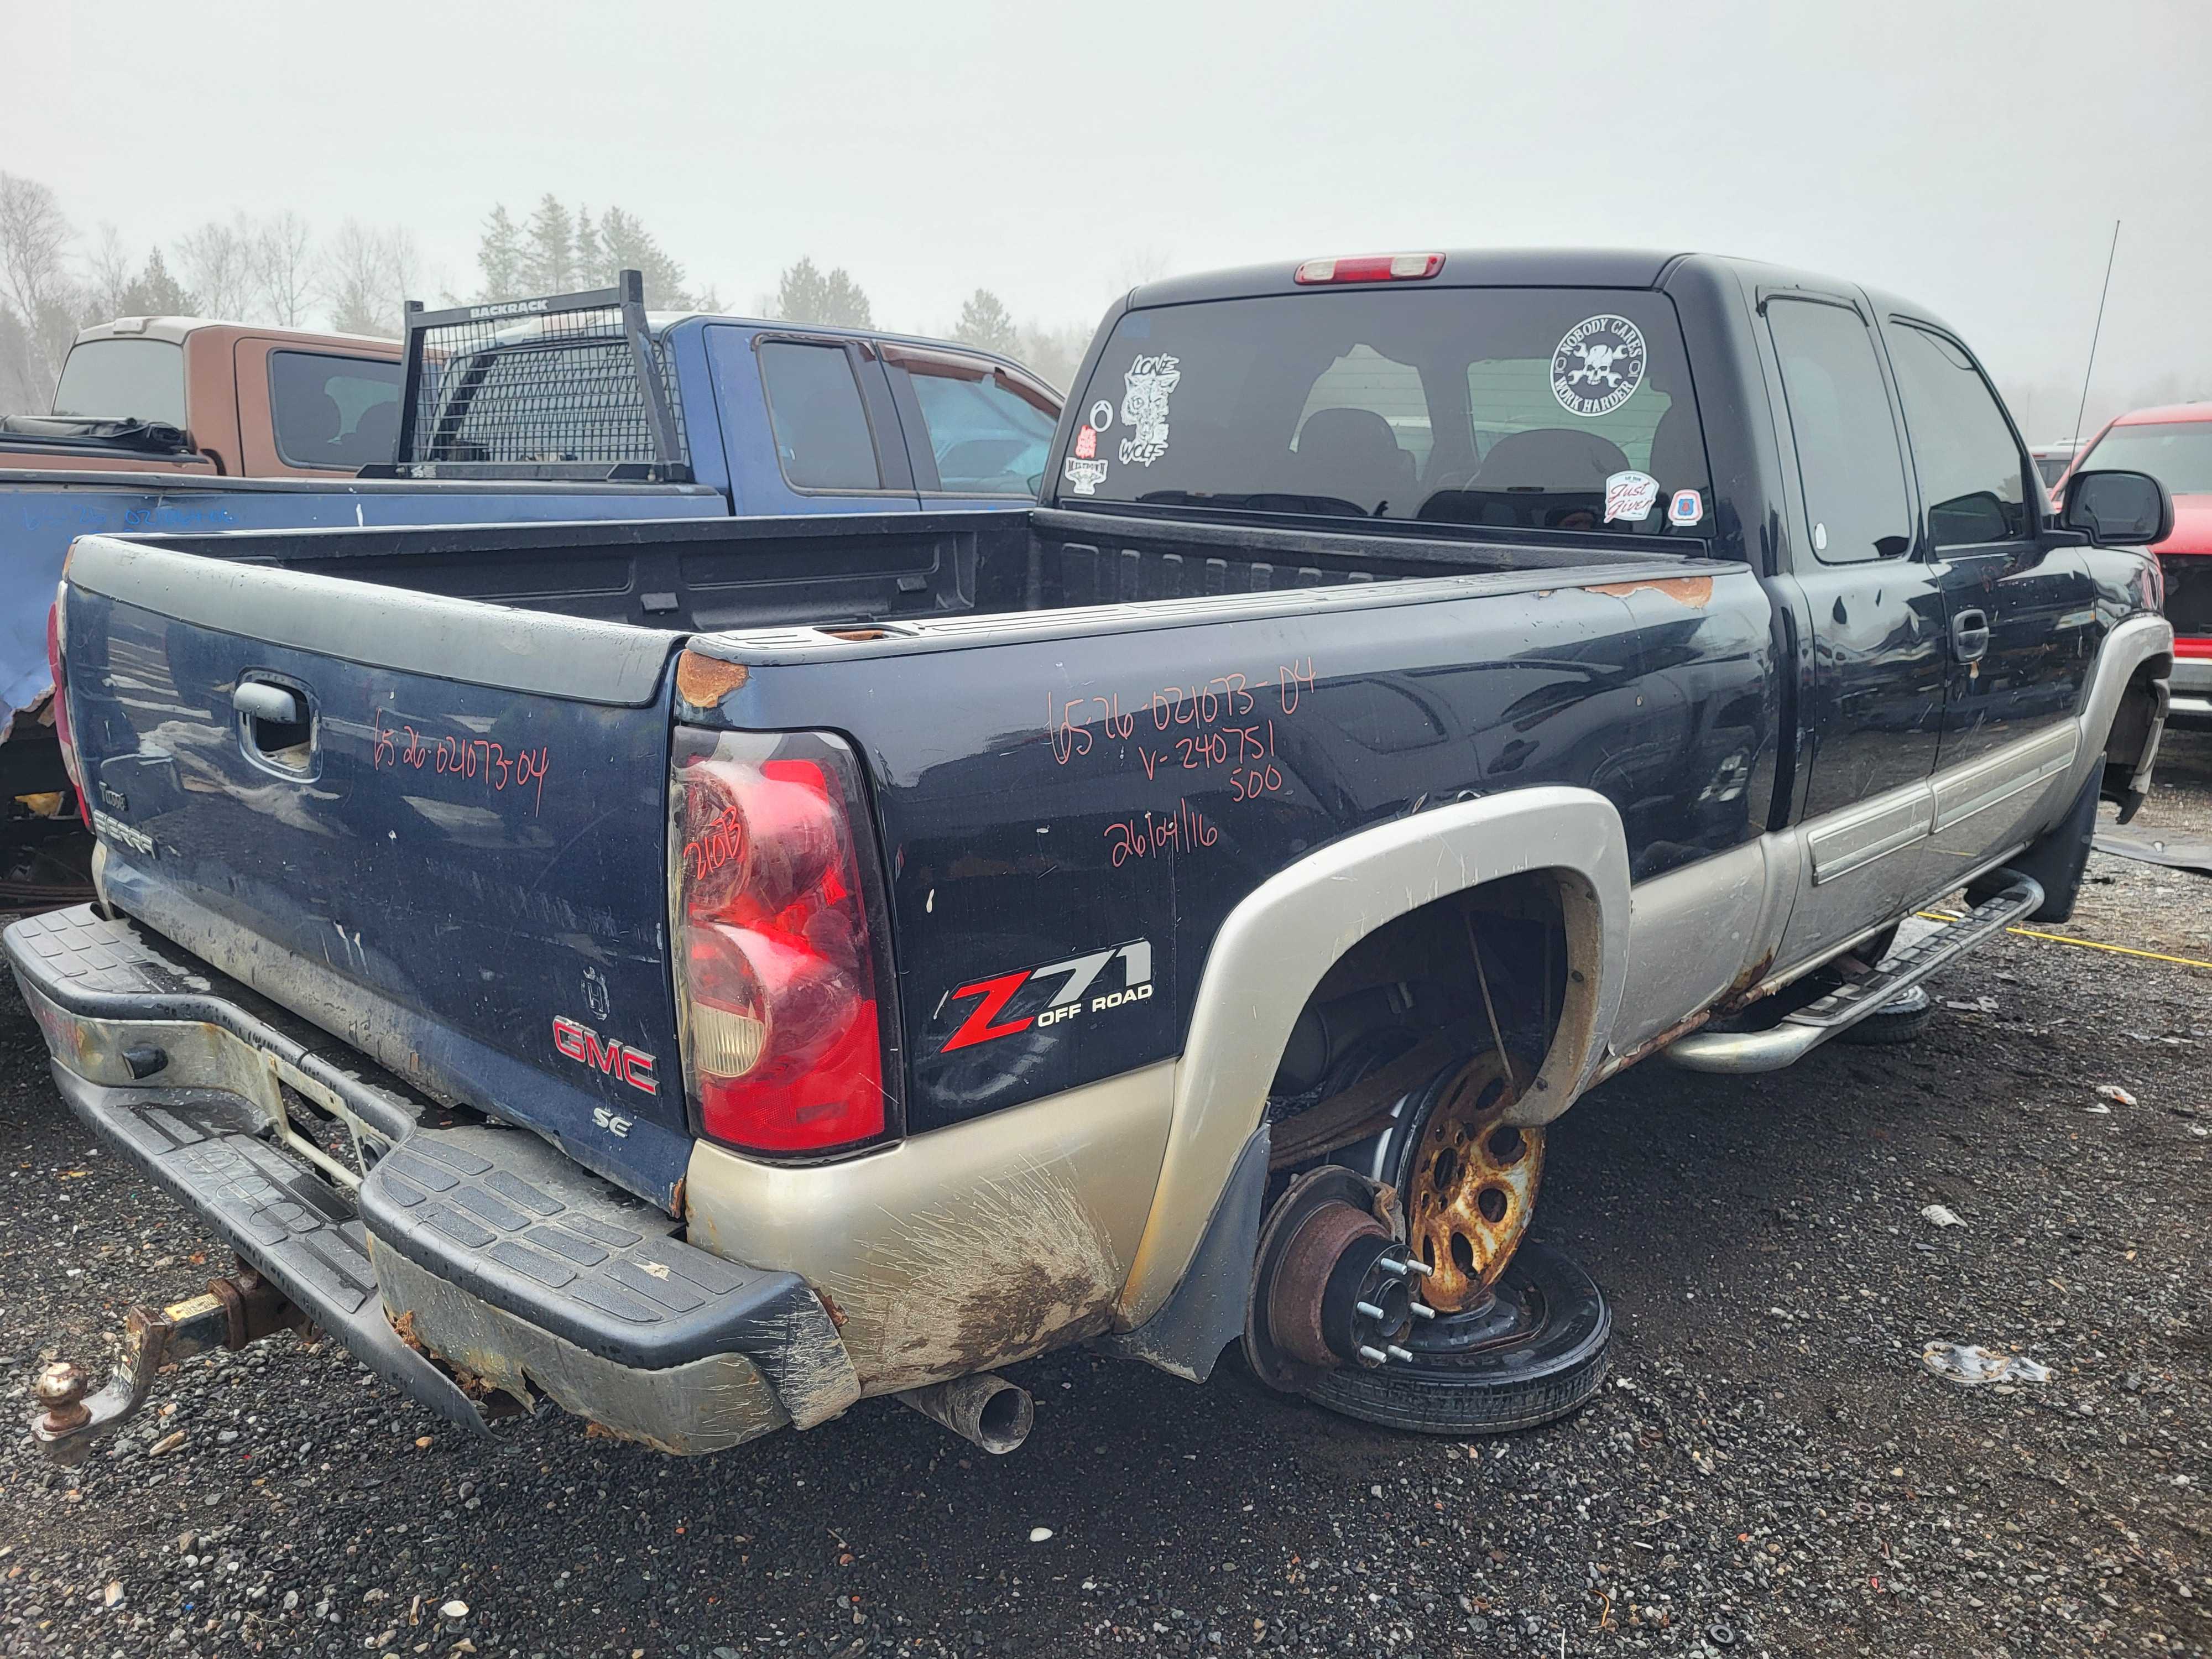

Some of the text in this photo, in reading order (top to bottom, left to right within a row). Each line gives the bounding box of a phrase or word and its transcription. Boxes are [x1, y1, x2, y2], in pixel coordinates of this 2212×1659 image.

[471, 299, 549, 319] BACKRACK
[1560, 318, 1642, 358] NOBODY CARES
[1131, 353, 1180, 376] LONE
[1554, 375, 1634, 413] WORK HARDER
[1608, 481, 1651, 503] Just
[1229, 763, 1282, 802] 500
[93, 809, 156, 860] SIERRA
[940, 940, 1152, 1053] Z71
[1037, 984, 1154, 1027] OFF ROAD
[552, 1014, 660, 1097] GMC
